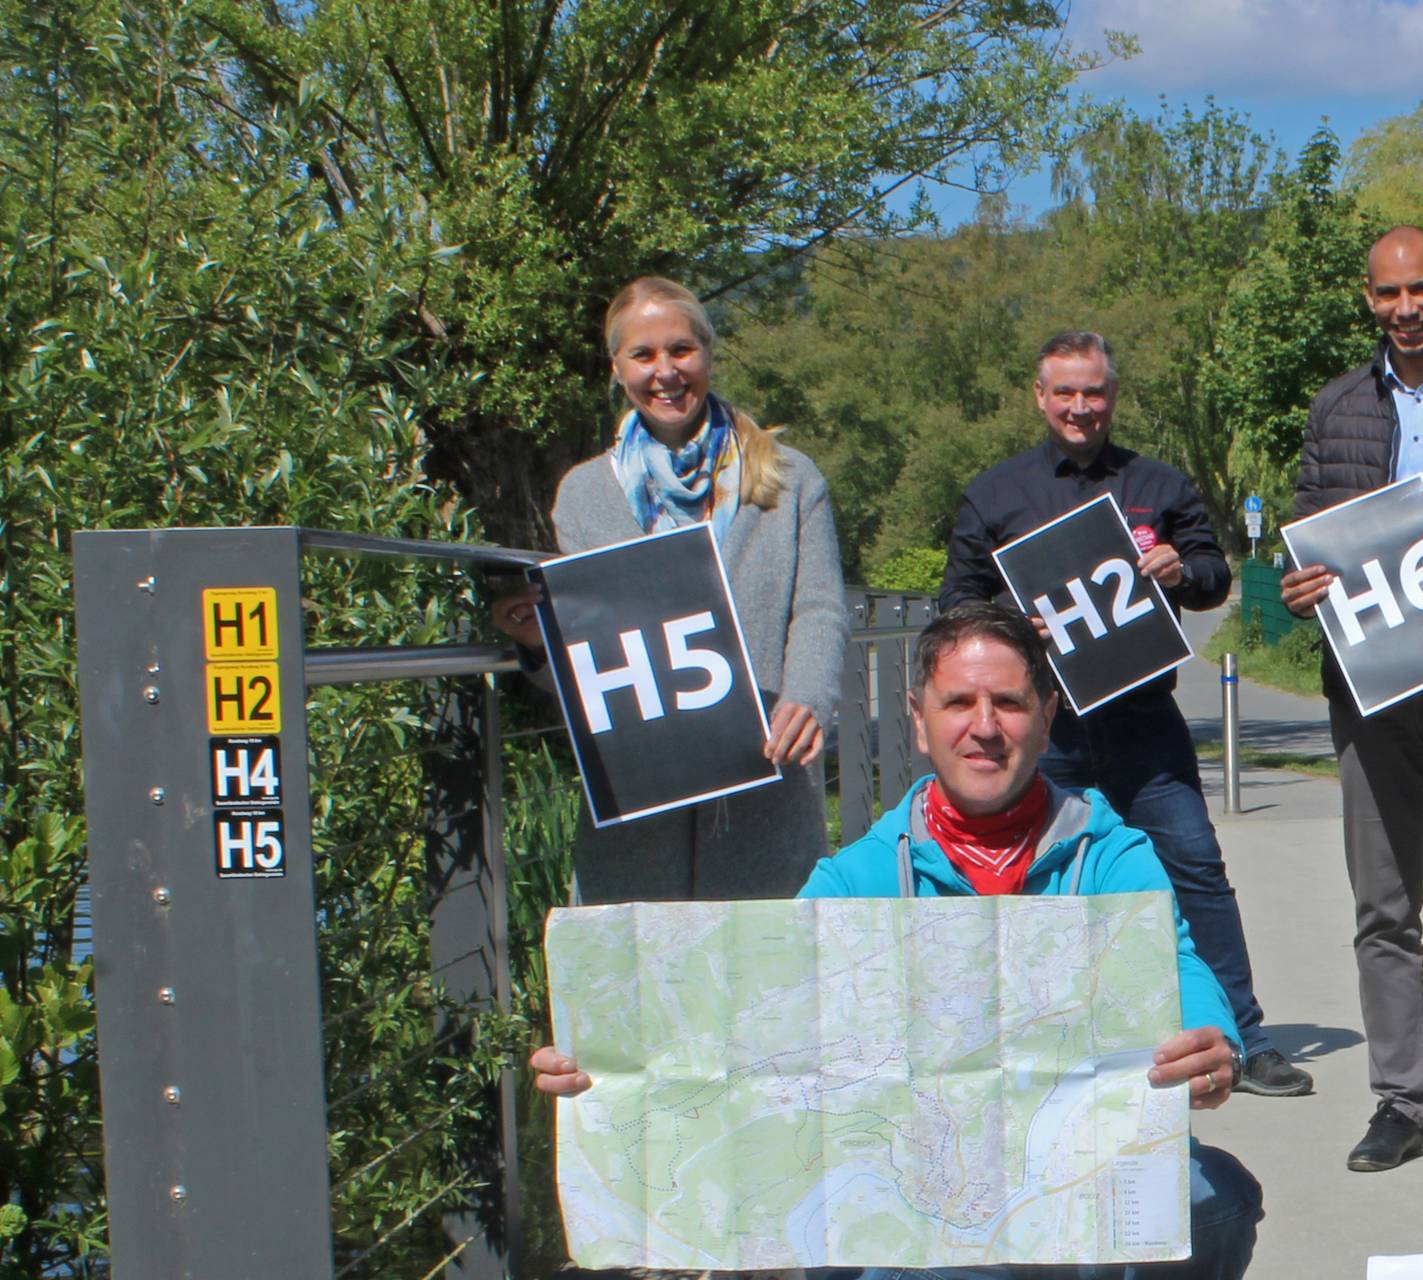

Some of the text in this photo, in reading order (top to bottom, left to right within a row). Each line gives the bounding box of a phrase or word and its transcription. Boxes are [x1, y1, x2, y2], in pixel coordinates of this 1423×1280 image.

[213, 602, 268, 647] H1
[1032, 557, 1155, 656] H2
[566, 610, 733, 734] H5
[214, 676, 274, 721] H2
[215, 749, 279, 797] H4
[219, 821, 282, 869] H5
